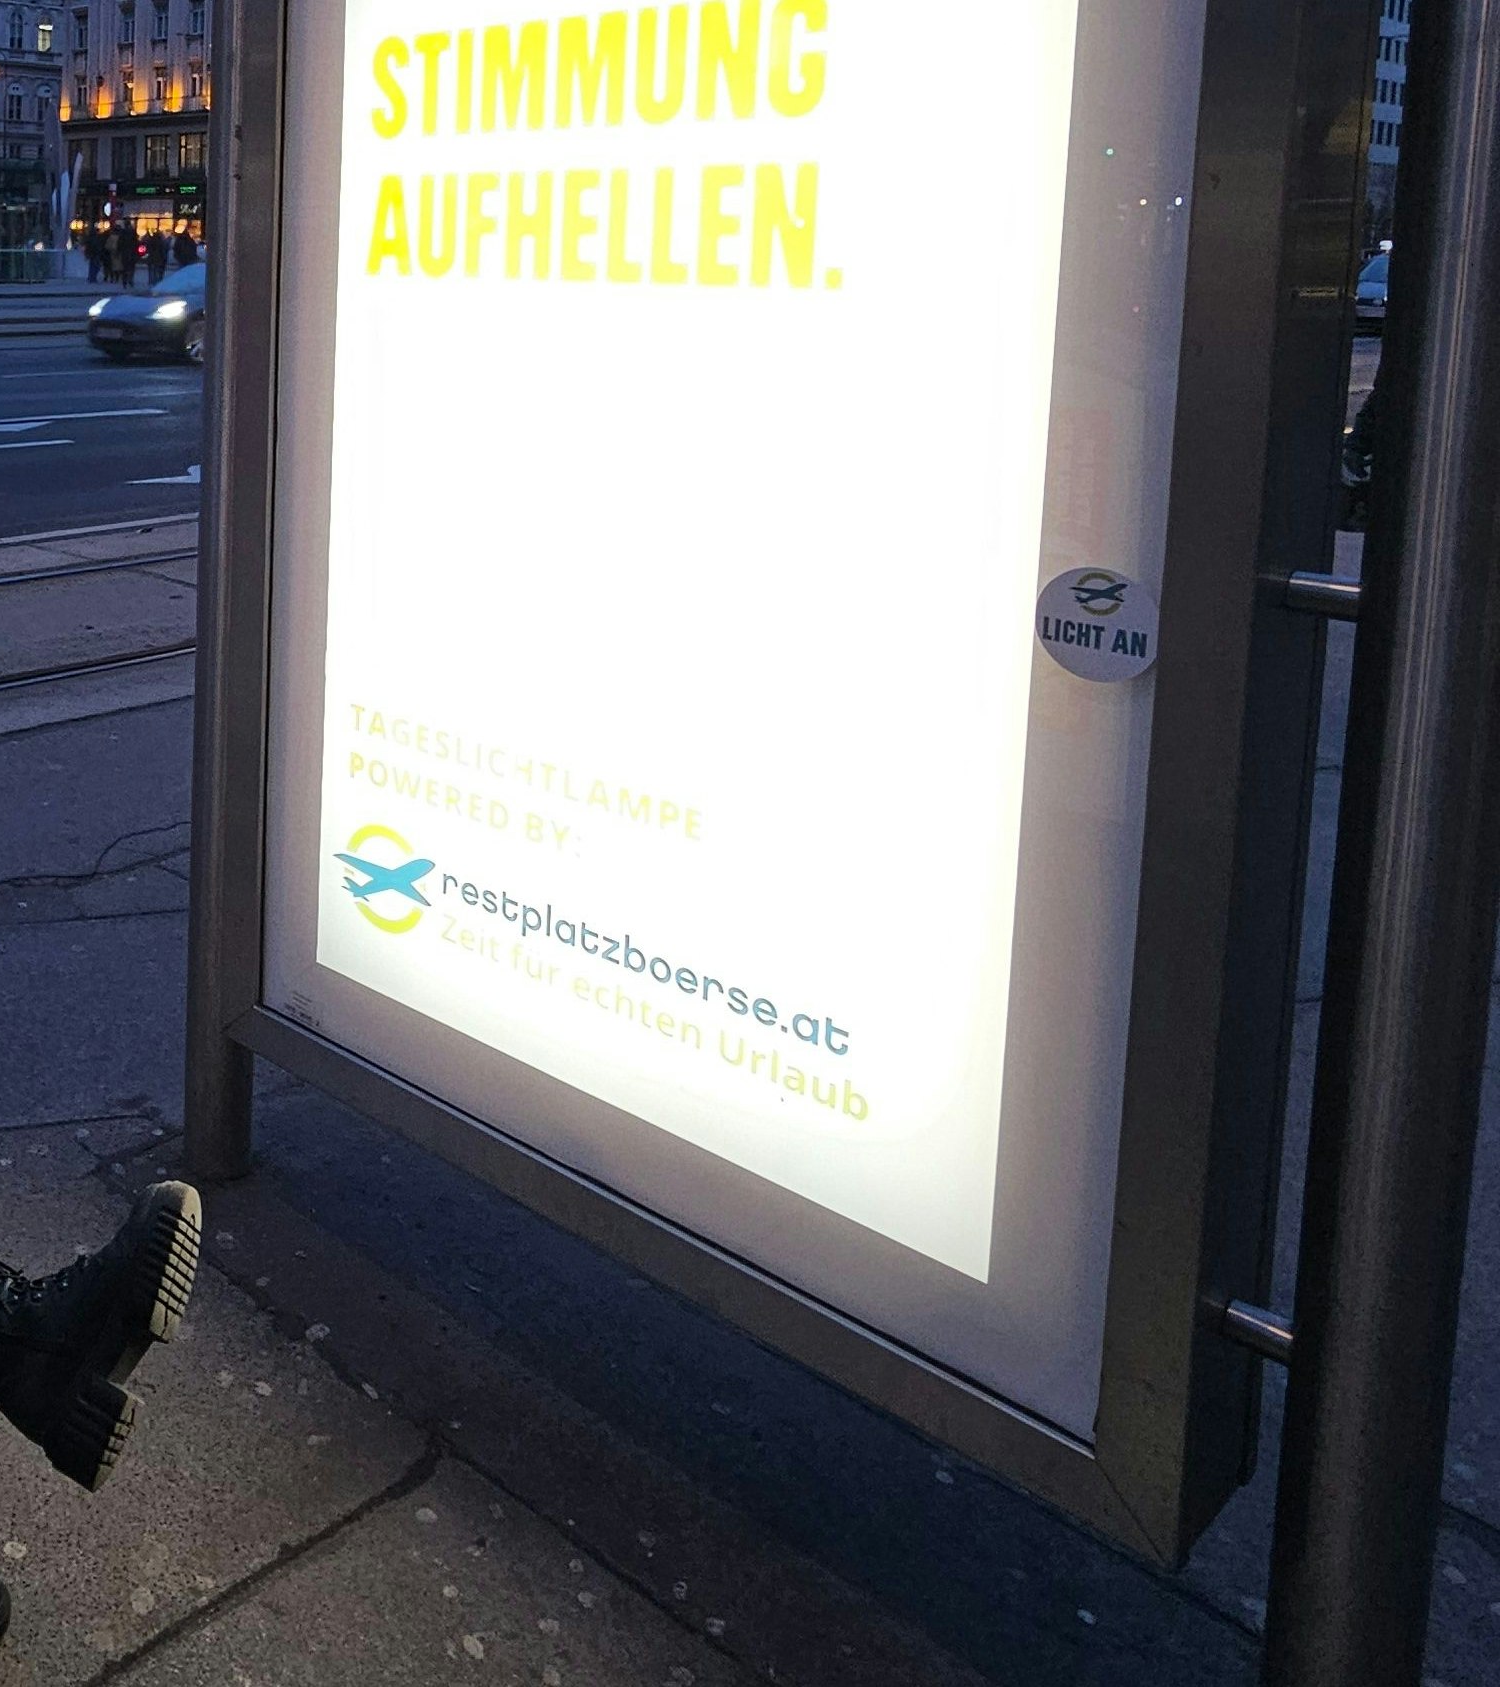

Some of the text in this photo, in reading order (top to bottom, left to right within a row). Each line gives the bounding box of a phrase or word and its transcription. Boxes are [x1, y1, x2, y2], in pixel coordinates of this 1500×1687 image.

[370, 0, 829, 140] STIMMUNG
[365, 161, 843, 290] AUFHELLEN.
[1042, 616, 1148, 659] LICHT AN
[348, 751, 581, 858] POWERED BY:
[349, 702, 703, 842] TAGESLICHTLAMPE
[439, 914, 870, 1122] Zeit für echten Urlaub
[441, 869, 852, 1056] restplatzboerse.at
